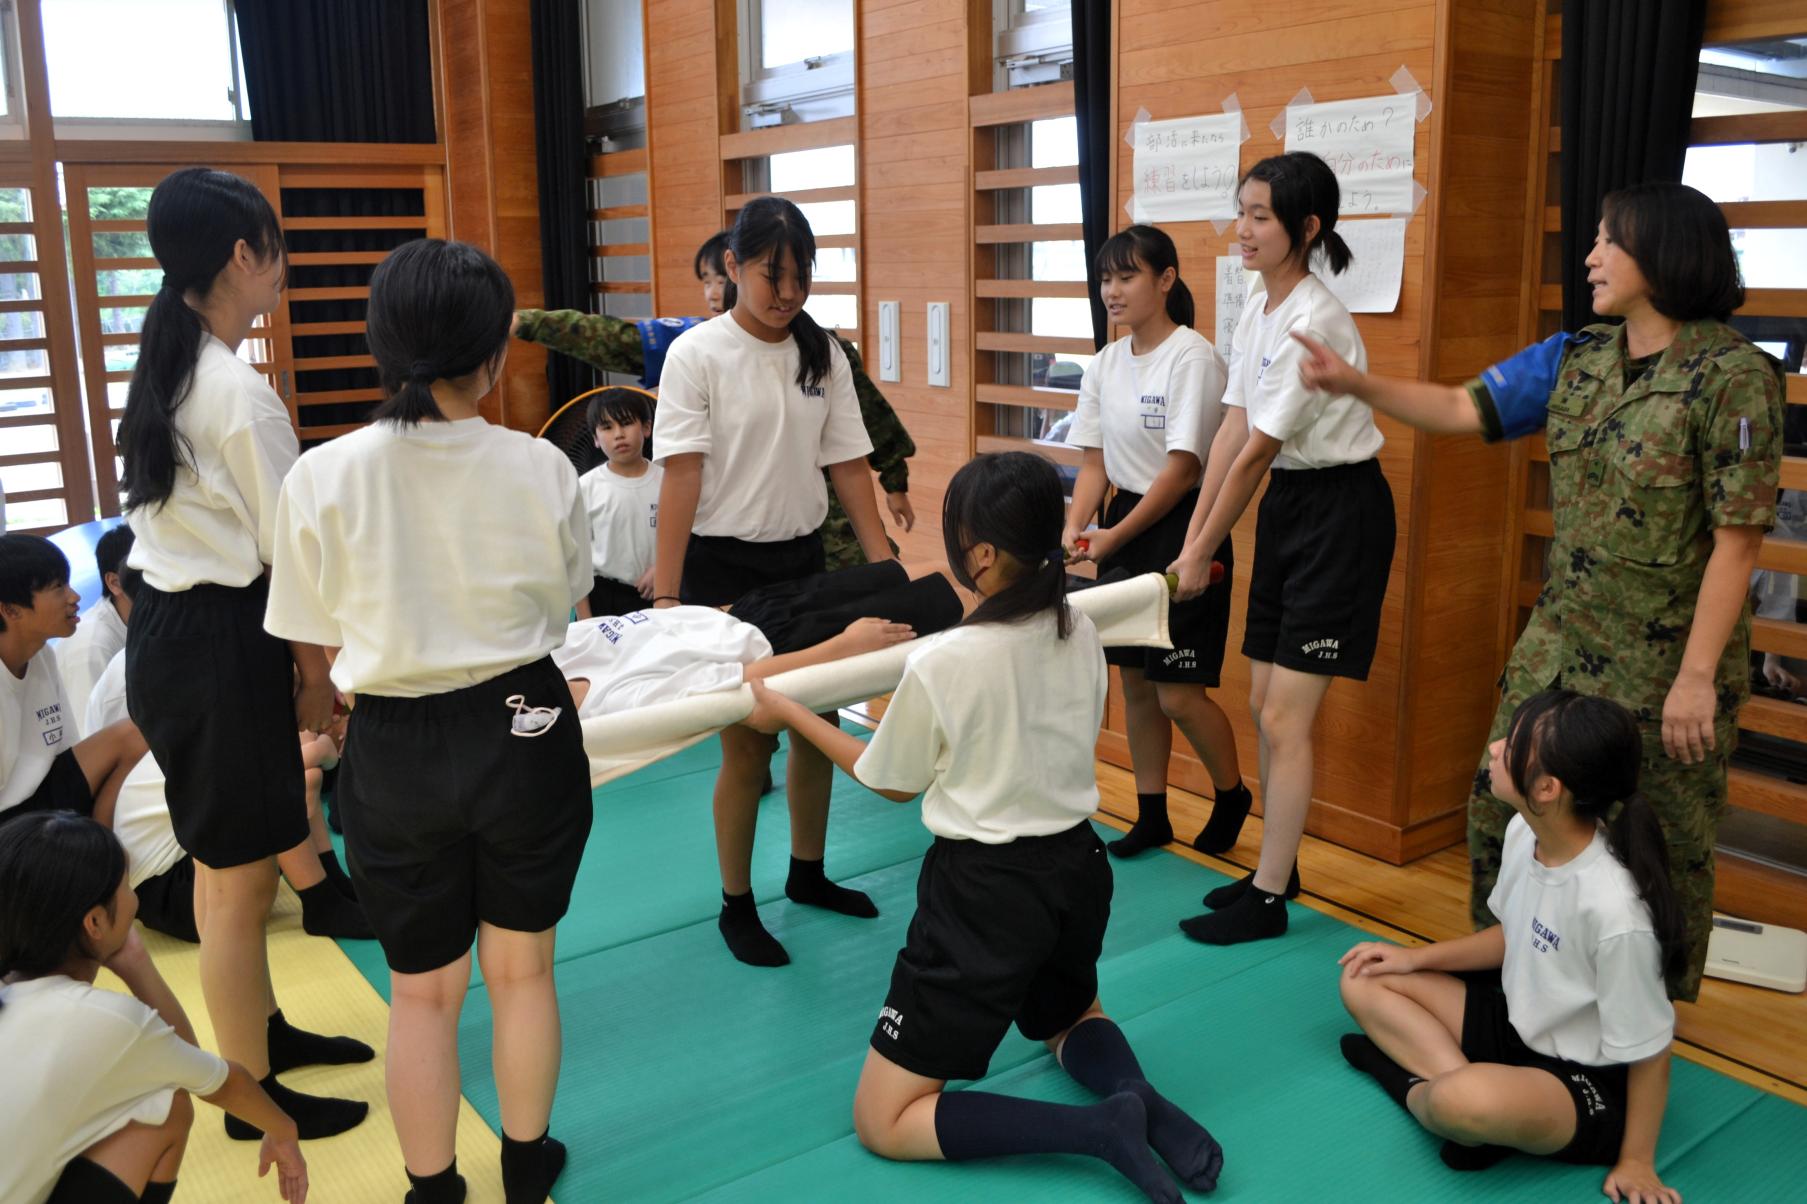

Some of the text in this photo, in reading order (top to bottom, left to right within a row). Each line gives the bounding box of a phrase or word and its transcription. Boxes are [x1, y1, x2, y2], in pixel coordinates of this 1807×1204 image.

[598, 622, 623, 645] MIGAW
[1301, 638, 1339, 655] MIGAWA
[1162, 648, 1196, 667] MIGAWA
[35, 702, 62, 721] MIGAW
